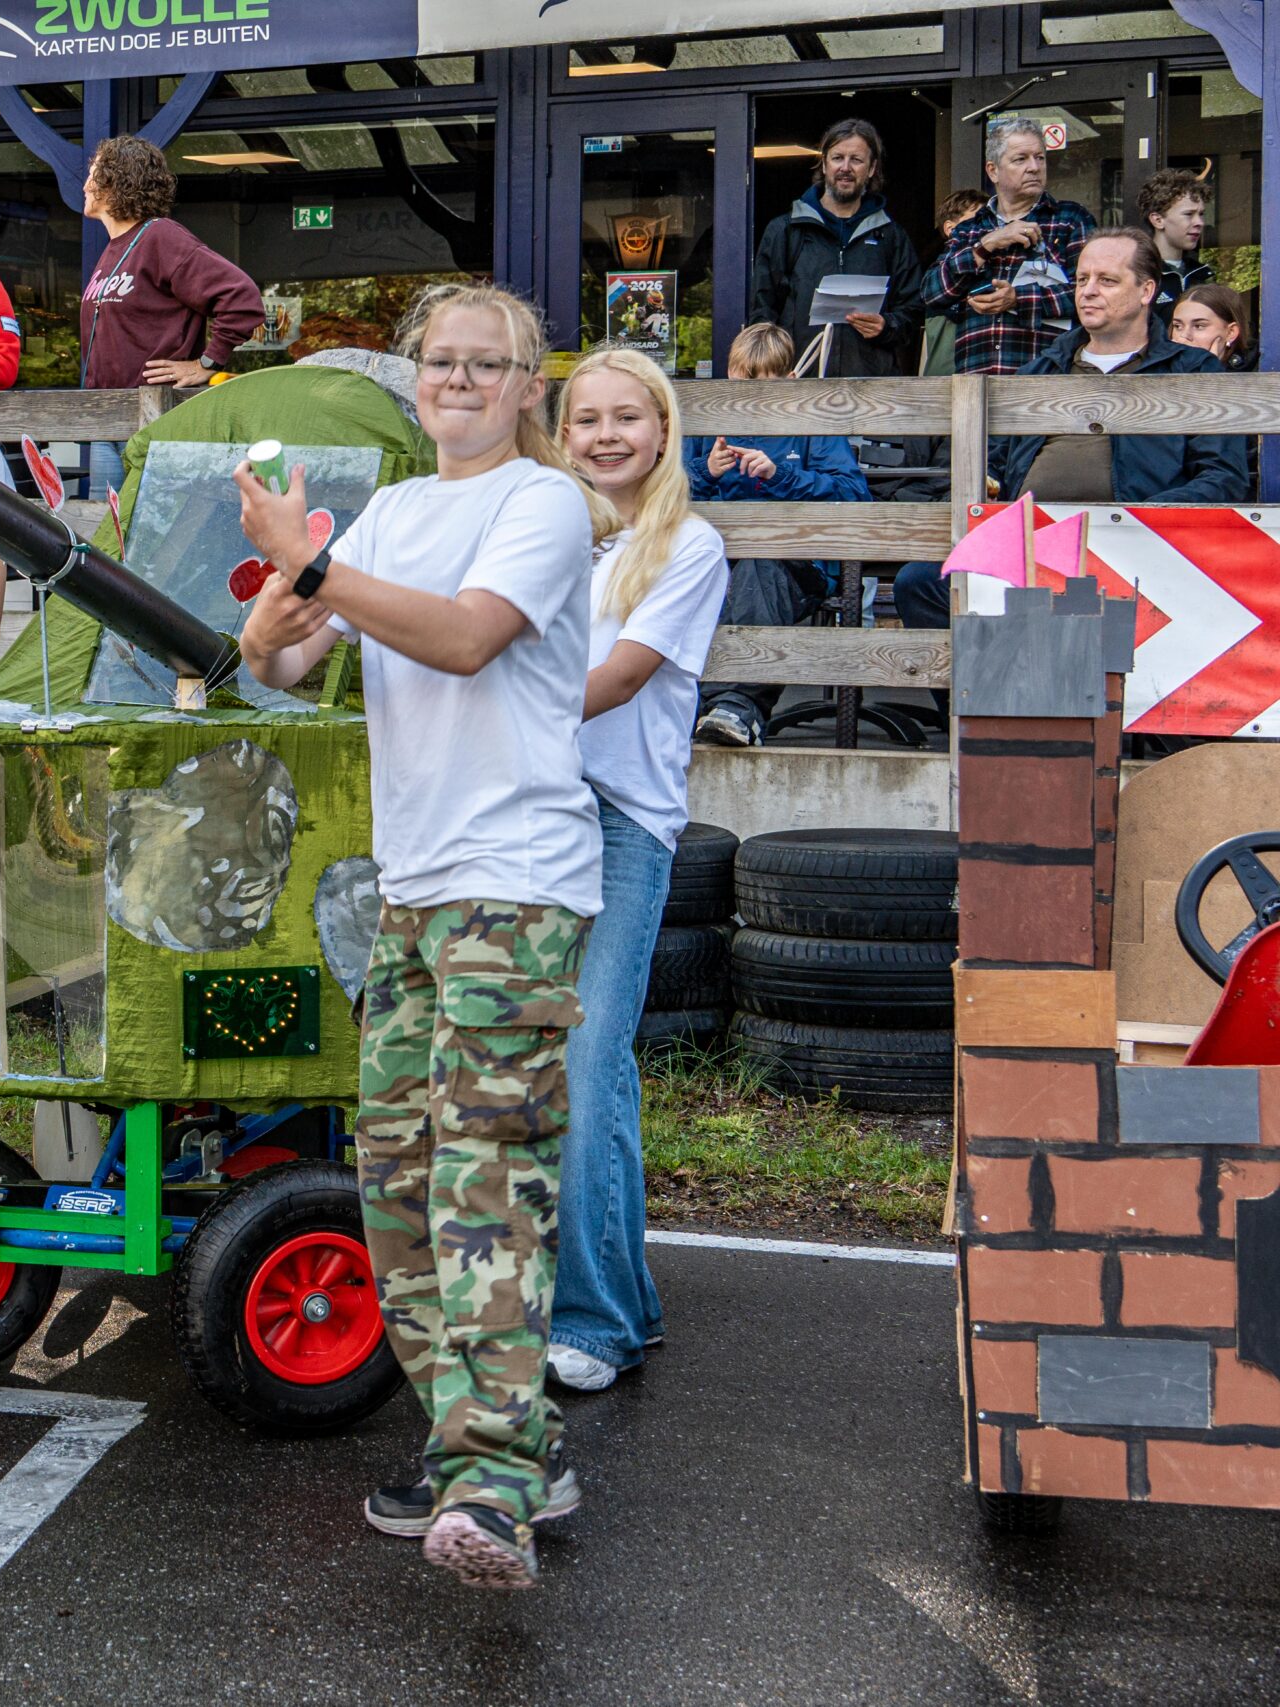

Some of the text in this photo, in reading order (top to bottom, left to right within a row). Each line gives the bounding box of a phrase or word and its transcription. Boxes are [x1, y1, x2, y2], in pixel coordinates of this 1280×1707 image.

[35, 24, 270, 57] KARTEN DOE JE BUITEN
[630, 281, 663, 291] 2026
